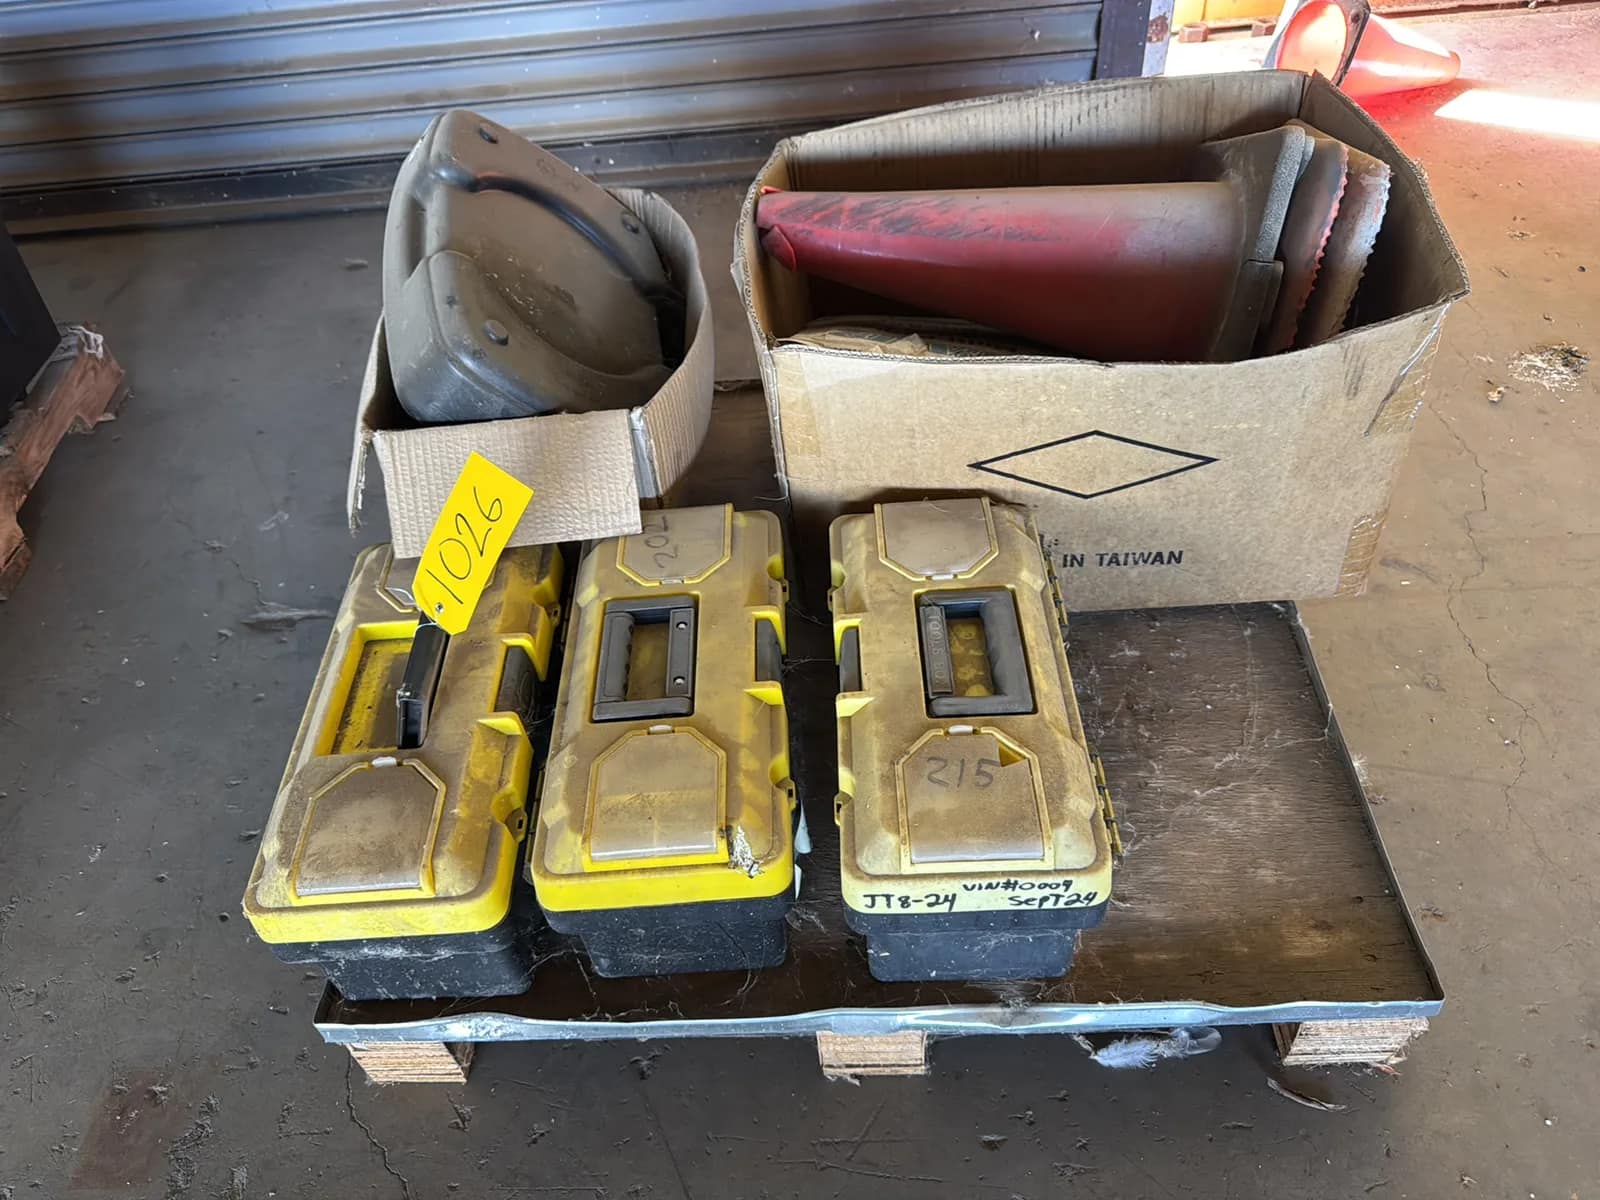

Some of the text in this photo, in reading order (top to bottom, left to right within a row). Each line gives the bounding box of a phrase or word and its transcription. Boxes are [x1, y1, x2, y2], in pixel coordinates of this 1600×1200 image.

[426, 486, 503, 605] 1026
[1062, 550, 1184, 568] IN TAIWAN
[926, 756, 1001, 788] 215
[1065, 891, 1098, 906] 24
